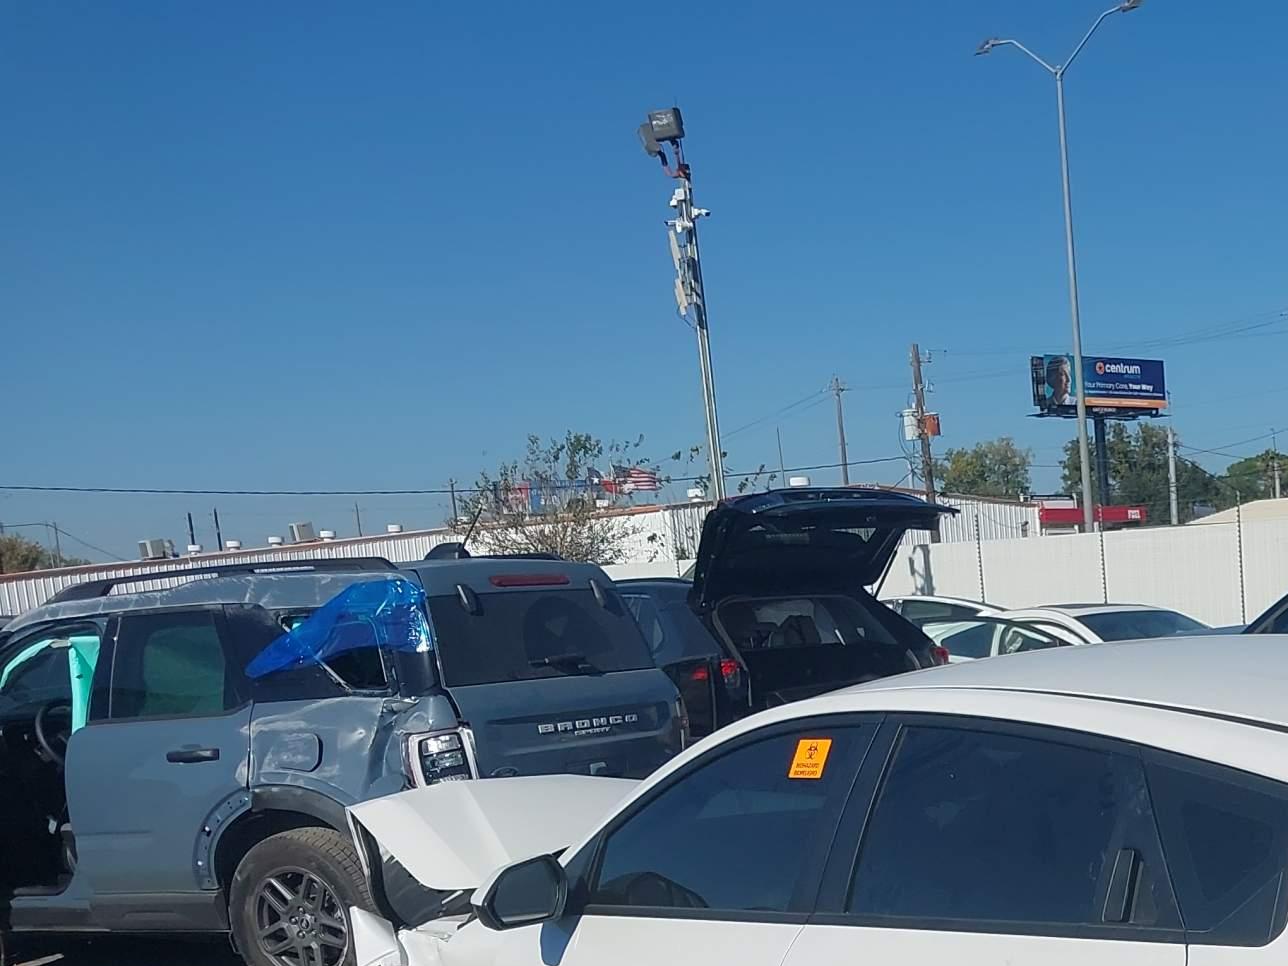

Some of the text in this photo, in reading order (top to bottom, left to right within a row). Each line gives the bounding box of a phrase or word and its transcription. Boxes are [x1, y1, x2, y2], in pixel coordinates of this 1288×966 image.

[1105, 363, 1141, 374] centrum
[537, 713, 638, 734] BRONCO
[574, 726, 611, 737] SPORT
